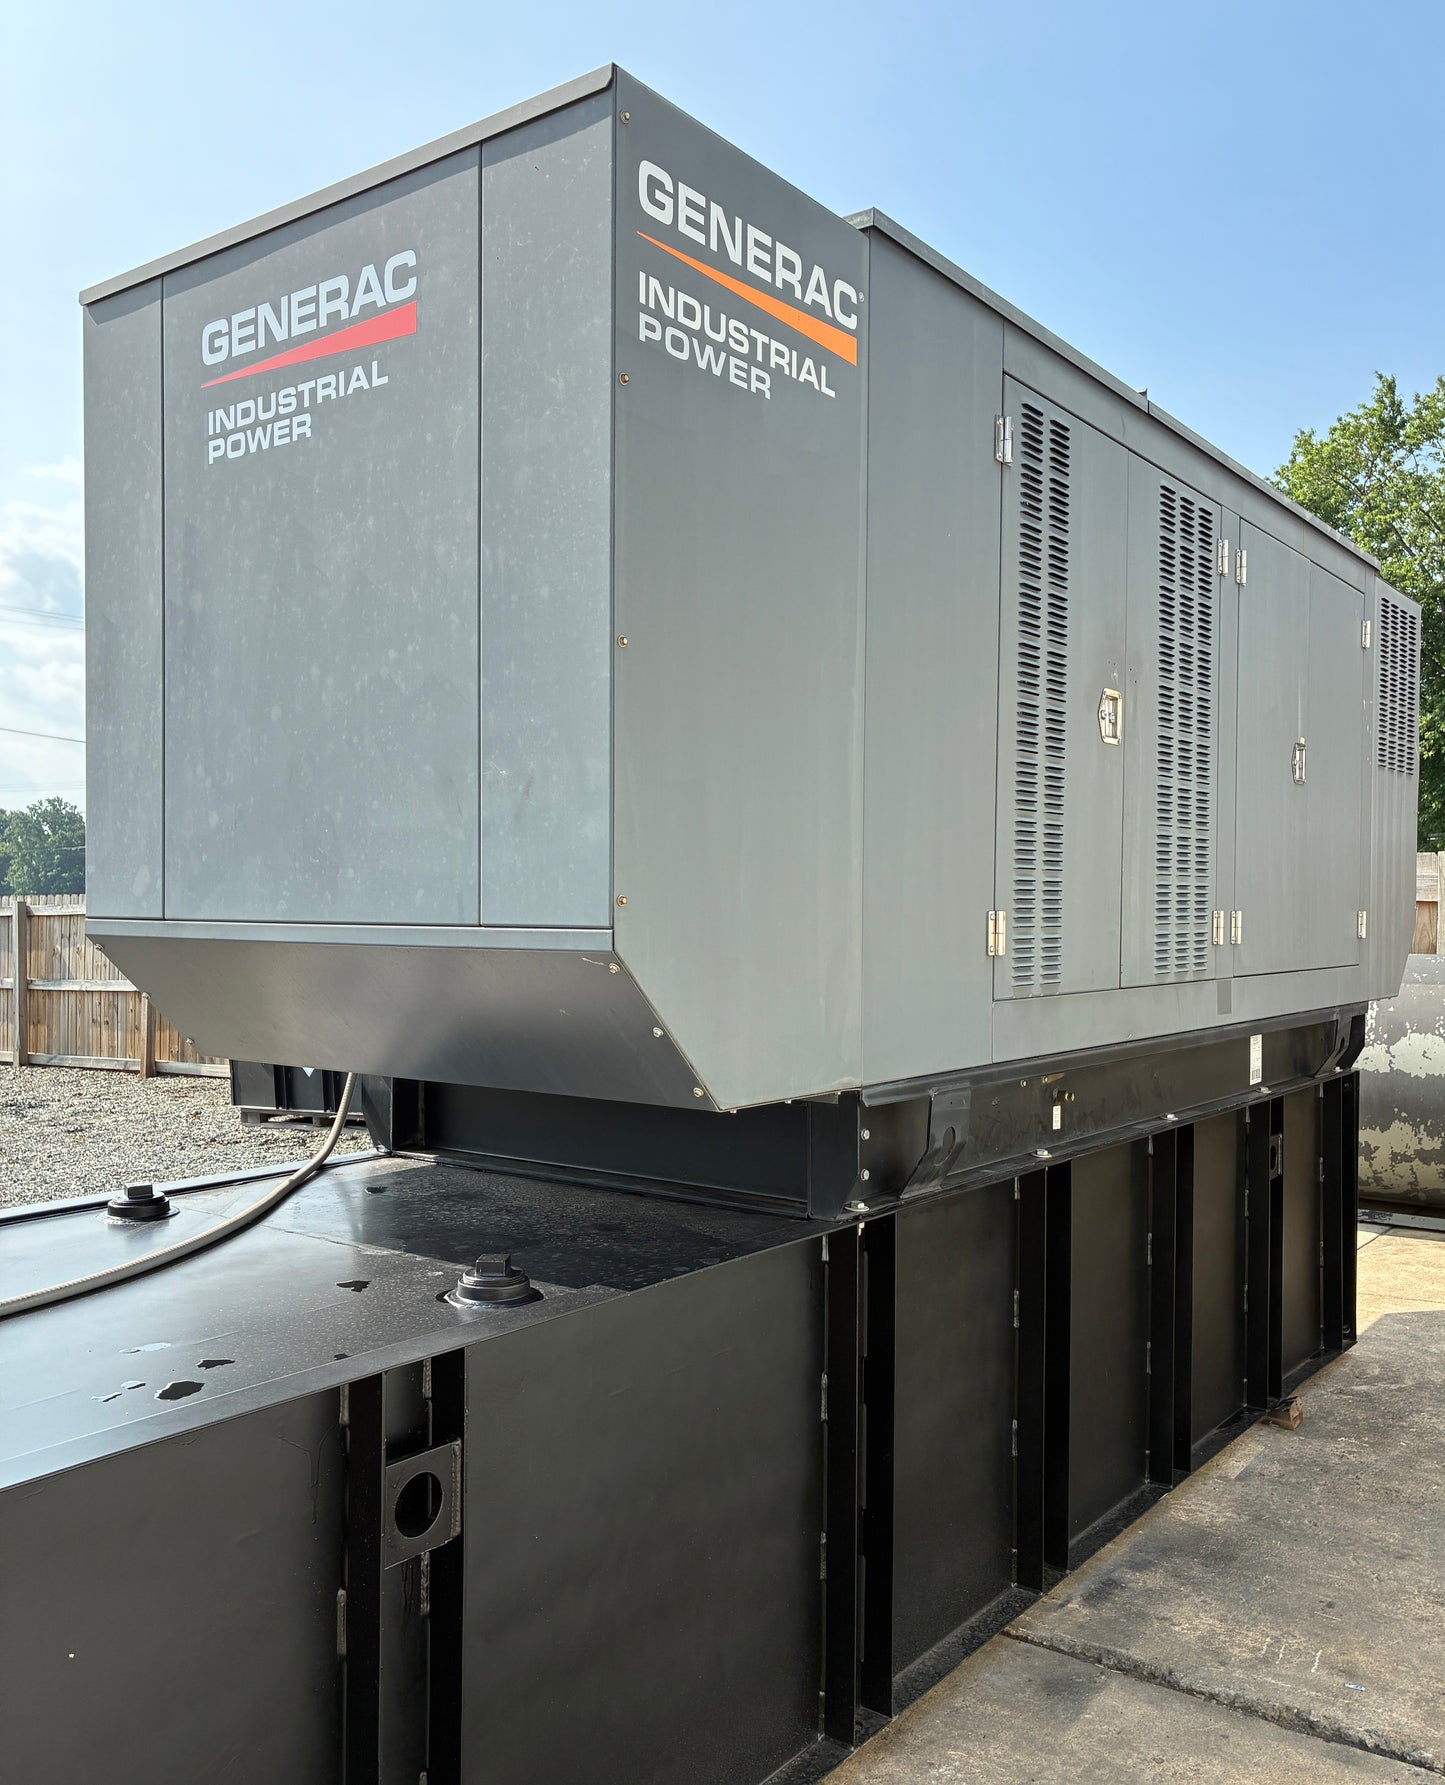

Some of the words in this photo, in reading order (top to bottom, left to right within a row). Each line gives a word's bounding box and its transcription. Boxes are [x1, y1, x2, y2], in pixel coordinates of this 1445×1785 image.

[638, 160, 857, 330] GENERAC
[202, 250, 417, 366] GENERAC
[639, 270, 836, 398] INDUSTRIAL
[639, 311, 771, 400] POWER
[208, 360, 389, 436] INDUSTRIAL
[208, 413, 312, 465] POWER
